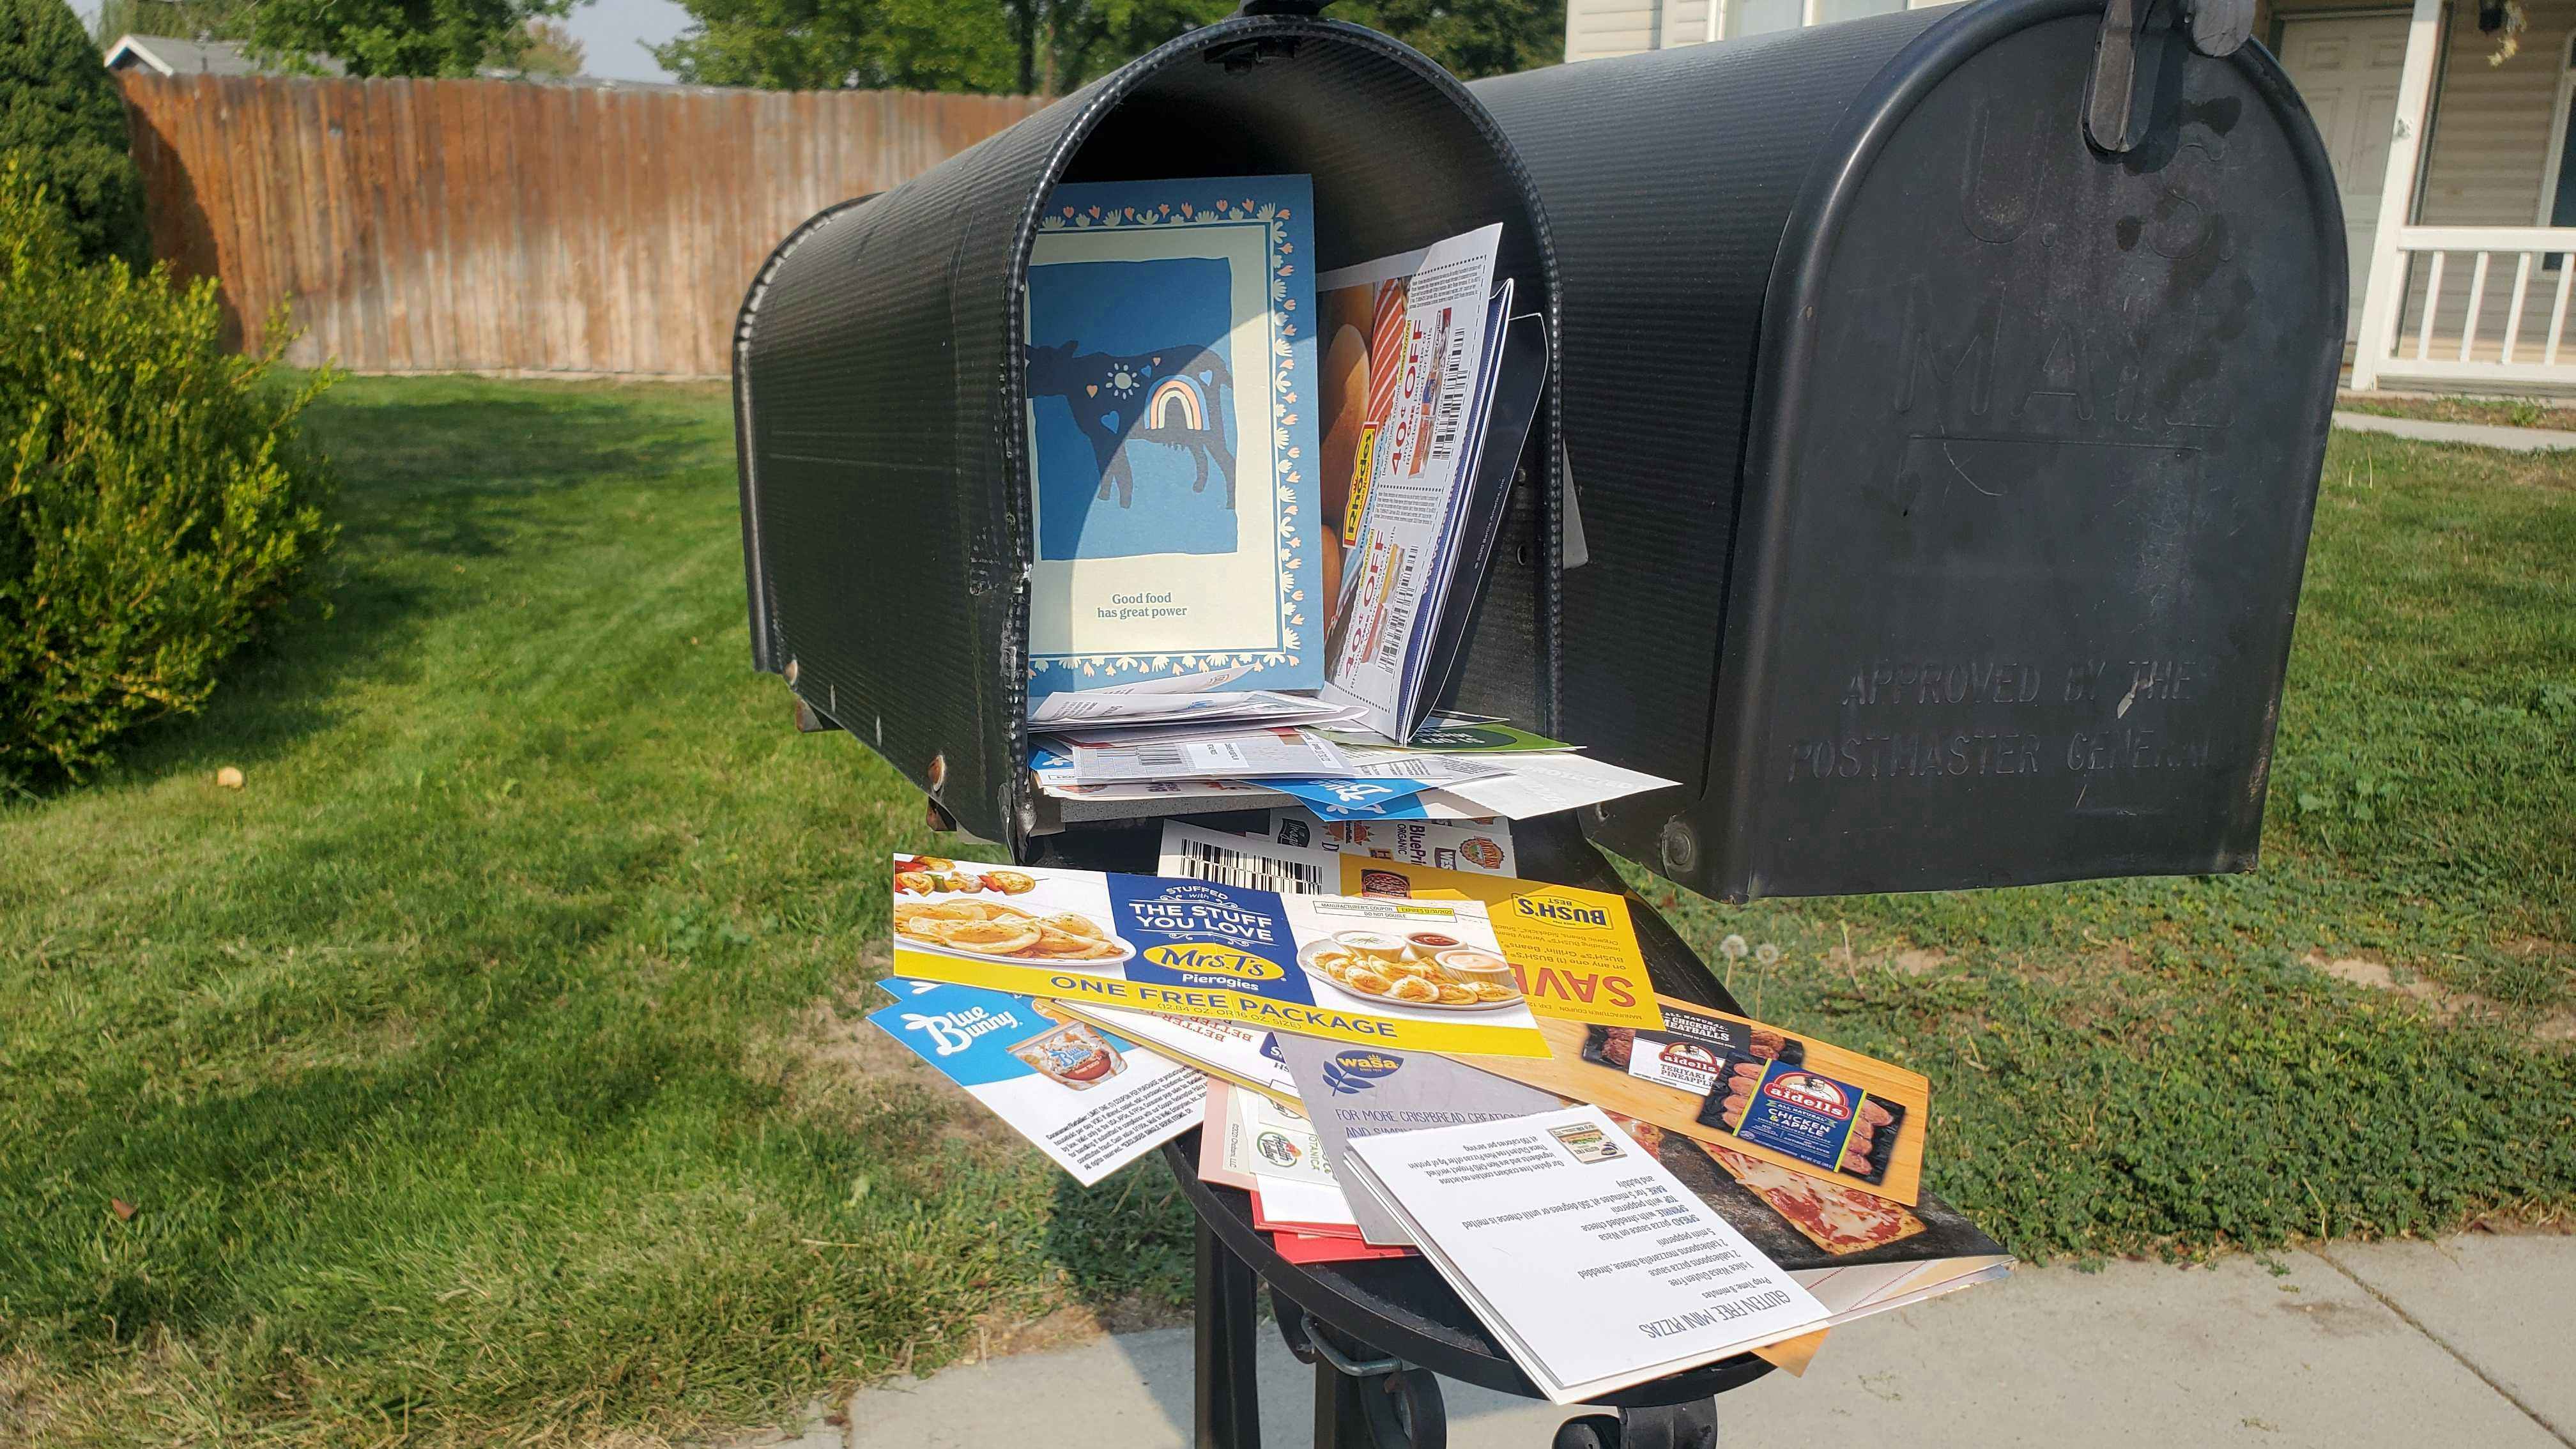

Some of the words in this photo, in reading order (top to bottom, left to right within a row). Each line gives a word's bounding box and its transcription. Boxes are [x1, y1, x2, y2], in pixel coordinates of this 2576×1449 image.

[1891, 275, 2236, 429] MAIL
[1404, 406, 1415, 437] ONE
[1413, 348, 1426, 401] package
[1423, 330, 1430, 344] of
[1392, 406, 1406, 475] 40¢
[1405, 320, 1422, 399] OFF
[1406, 418, 1418, 464] Rhodes
[1413, 377, 1425, 414] Bread
[1423, 362, 1427, 373] or
[1347, 433, 1371, 533] Rhodes
[1364, 530, 1383, 607] OFF
[1112, 593, 1144, 604] Good
[1145, 592, 1172, 604] food
[1097, 607, 1117, 618] has
[1119, 607, 1149, 620] great
[1151, 607, 1188, 619] power
[1841, 659, 2043, 705] APPROVED
[2063, 659, 2105, 703] BY
[2125, 659, 2200, 703] THE
[1787, 731, 2043, 783] POSTMASTER
[1398, 824, 1407, 855] ORGANIC
[1165, 885, 1229, 901] STUFFED
[1188, 891, 1210, 900] with
[1128, 902, 1187, 918] THE
[1191, 905, 1273, 928] STUFF
[1515, 896, 1607, 926] BUSH'S
[1135, 916, 1200, 930] YOU
[1203, 917, 1273, 942] LOVE
[1181, 972, 1259, 992] Pierogies
[1050, 976, 1128, 998] ONE
[1138, 988, 1229, 1009] FREE
[1239, 997, 1399, 1039] PACKAGE
[1157, 1001, 1190, 1013] (12.84
[1193, 1007, 1213, 1015] OZ.
[1250, 1013, 1270, 1023] OZ.
[1273, 1017, 1303, 1030] SIZE)
[1588, 1010, 1642, 1020] MANUFACTURER
[1162, 1014, 1227, 1043] BETTER
[1671, 1017, 1718, 1032] CHICKEN
[1336, 1056, 1399, 1070] wasa
[1664, 1053, 1717, 1072] aidells
[1660, 1064, 1705, 1080] TERIYAKI
[1770, 1084, 1842, 1116] aidells
[1777, 1101, 1791, 1110] ALL
[1335, 1108, 1360, 1121] FOR
[1361, 1110, 1396, 1122] MORE
[1399, 1111, 1466, 1123] CRISPBREAD
[1768, 1105, 1830, 1133] CHICKEN
[1345, 1126, 1371, 1138] AND
[1781, 1117, 1824, 1137] APPLE
[1229, 1158, 1238, 1168] LLC
[1521, 1152, 1556, 1162] ingredients
[1407, 1160, 1431, 1169] protein
[1450, 1165, 1475, 1174] Project
[1473, 1162, 1501, 1171] Non-GMO
[1531, 1161, 1552, 1170] gluten
[1616, 1178, 1643, 1188] bubbly
[1639, 1176, 1655, 1184] and
[1646, 1185, 1667, 1195] BAKE
[1600, 1193, 1630, 1203] minutes
[1644, 1197, 1663, 1206] with
[1663, 1195, 1678, 1203] TOP
[1549, 1202, 1578, 1213] degrees
[1577, 1200, 1593, 1209] 350
[1611, 1200, 1646, 1214] pepperoni
[1655, 1204, 1689, 1217] SPRINKLE
[1496, 1213, 1522, 1222] cheese
[1522, 1209, 1542, 1220] until
[1637, 1211, 1657, 1220] with
[1671, 1215, 1700, 1225] SPREAD
[1462, 1218, 1489, 1230] melted
[1581, 1222, 1607, 1231] cheese
[1606, 1215, 1639, 1228] shredded
[1650, 1219, 1671, 1229] pizza
[1629, 1225, 1652, 1234] sauce
[1690, 1229, 1708, 1239] mini
[1598, 1232, 1623, 1240] Wasa
[1656, 1231, 1692, 1247] pepperoni
[1677, 1240, 1722, 1254] tablespoons
[1638, 1250, 1679, 1264] mozzarella
[1690, 1252, 1735, 1266] tablespoons
[1609, 1259, 1639, 1269] cheese,
[1669, 1260, 1692, 1271] pizza
[1728, 1262, 1747, 1271] slice
[1577, 1266, 1613, 1279] shredded
[1648, 1266, 1671, 1276] sauce
[1683, 1272, 1712, 1282] Gluten
[1708, 1267, 1733, 1276] Wasa
[1668, 1278, 1688, 1286] Free
[1733, 1281, 1756, 1289] Time:
[1752, 1276, 1772, 1285] Prep
[1702, 1287, 1731, 1298] minutes
[1740, 1291, 1790, 1312] GLUTEN
[1710, 1301, 1748, 1321] FREE
[1680, 1309, 1717, 1328] MINI
[1639, 1317, 1687, 1338] PIZZAS
